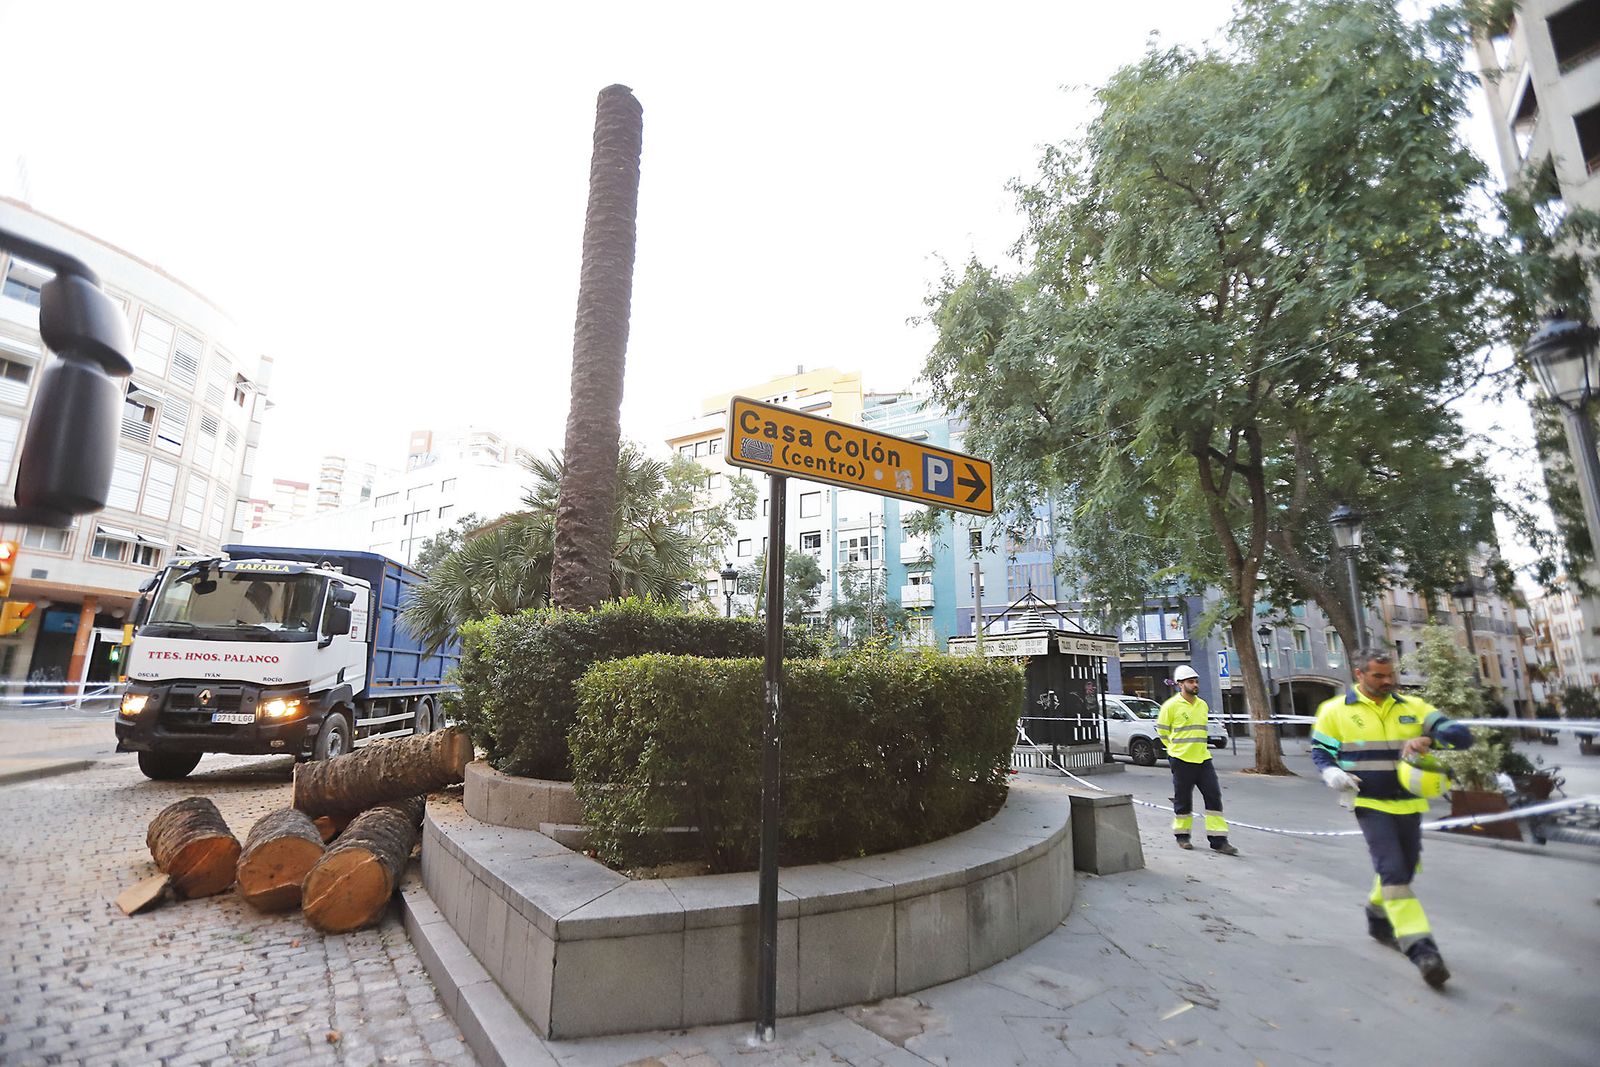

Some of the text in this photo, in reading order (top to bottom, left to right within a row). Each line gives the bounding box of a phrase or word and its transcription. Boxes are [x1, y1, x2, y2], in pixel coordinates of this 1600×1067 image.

[740, 410, 901, 468] Casa Colón
[781, 445, 865, 480] (centro)
[927, 457, 949, 491] P
[235, 563, 289, 572] RAFAELA
[148, 651, 279, 664] TTES. HNOS. PALANCO
[217, 714, 236, 722] 2713
